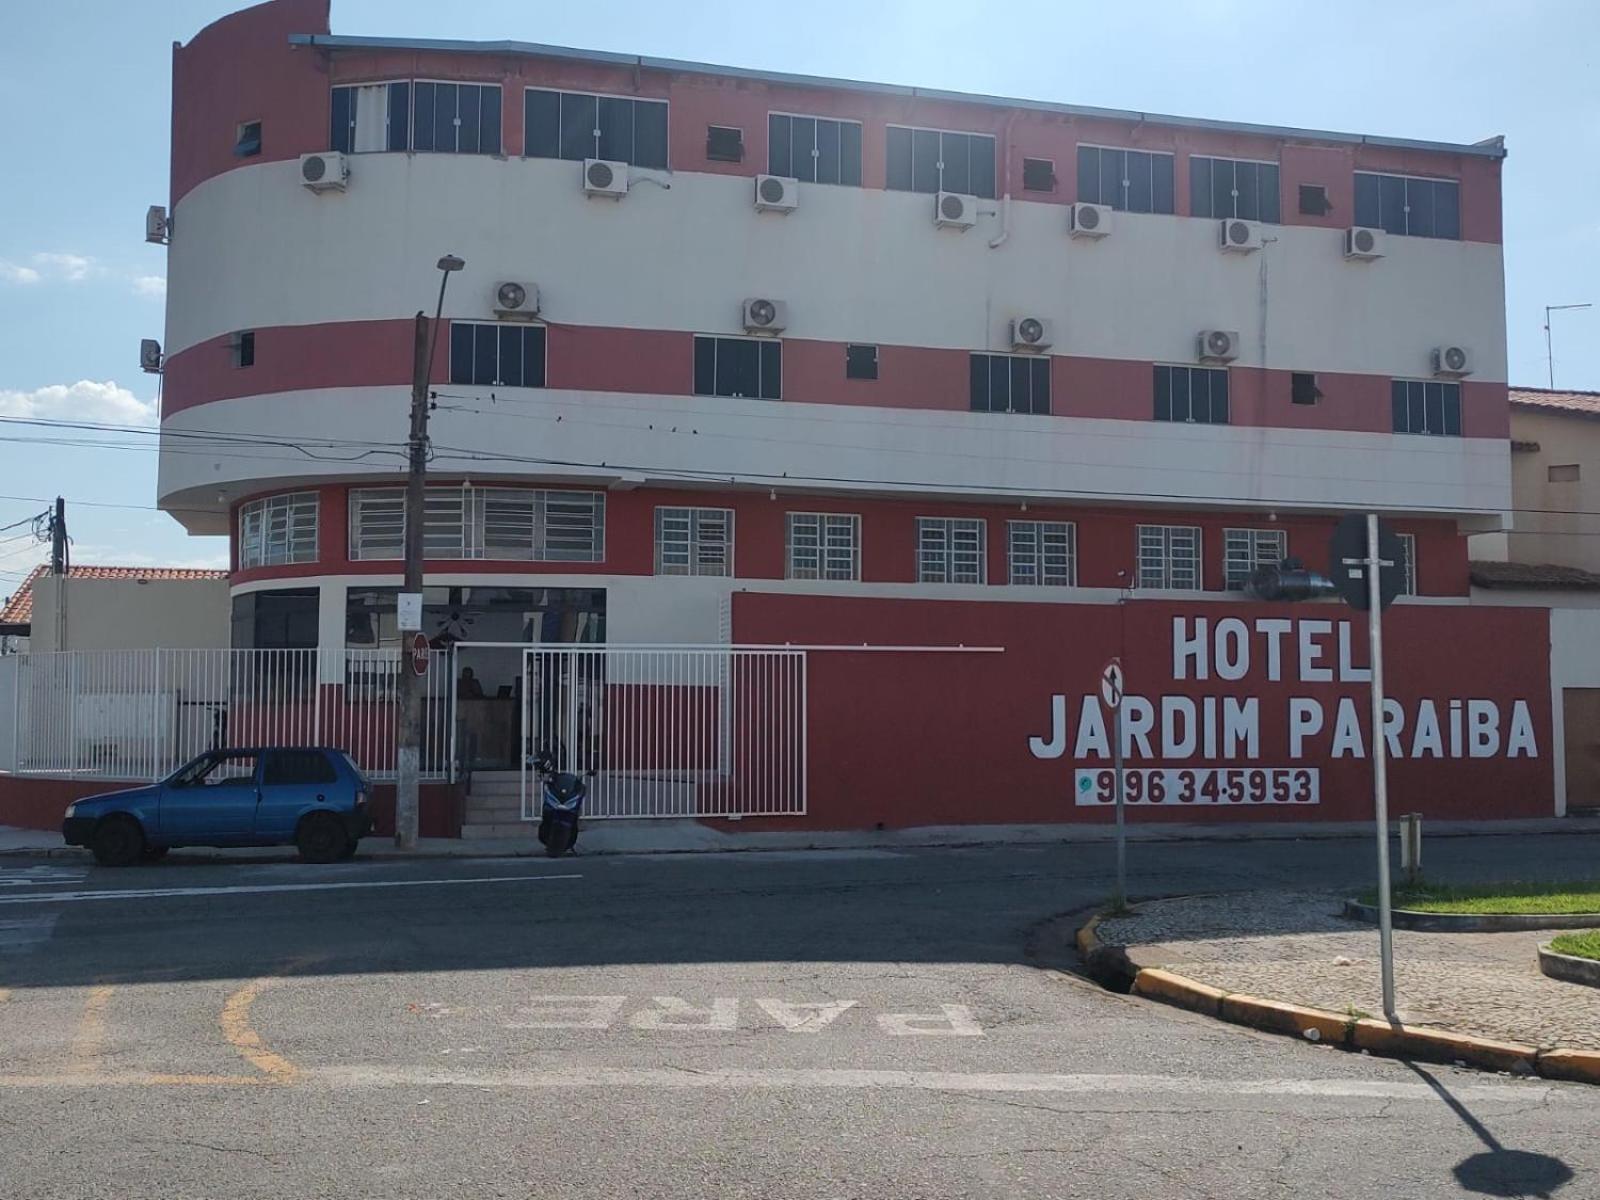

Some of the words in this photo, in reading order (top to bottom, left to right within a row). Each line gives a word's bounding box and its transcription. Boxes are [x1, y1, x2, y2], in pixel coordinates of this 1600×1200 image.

[1173, 617, 1372, 682] HOTEL
[1029, 695, 1259, 759] JARDIM
[502, 996, 986, 1036] PARE
